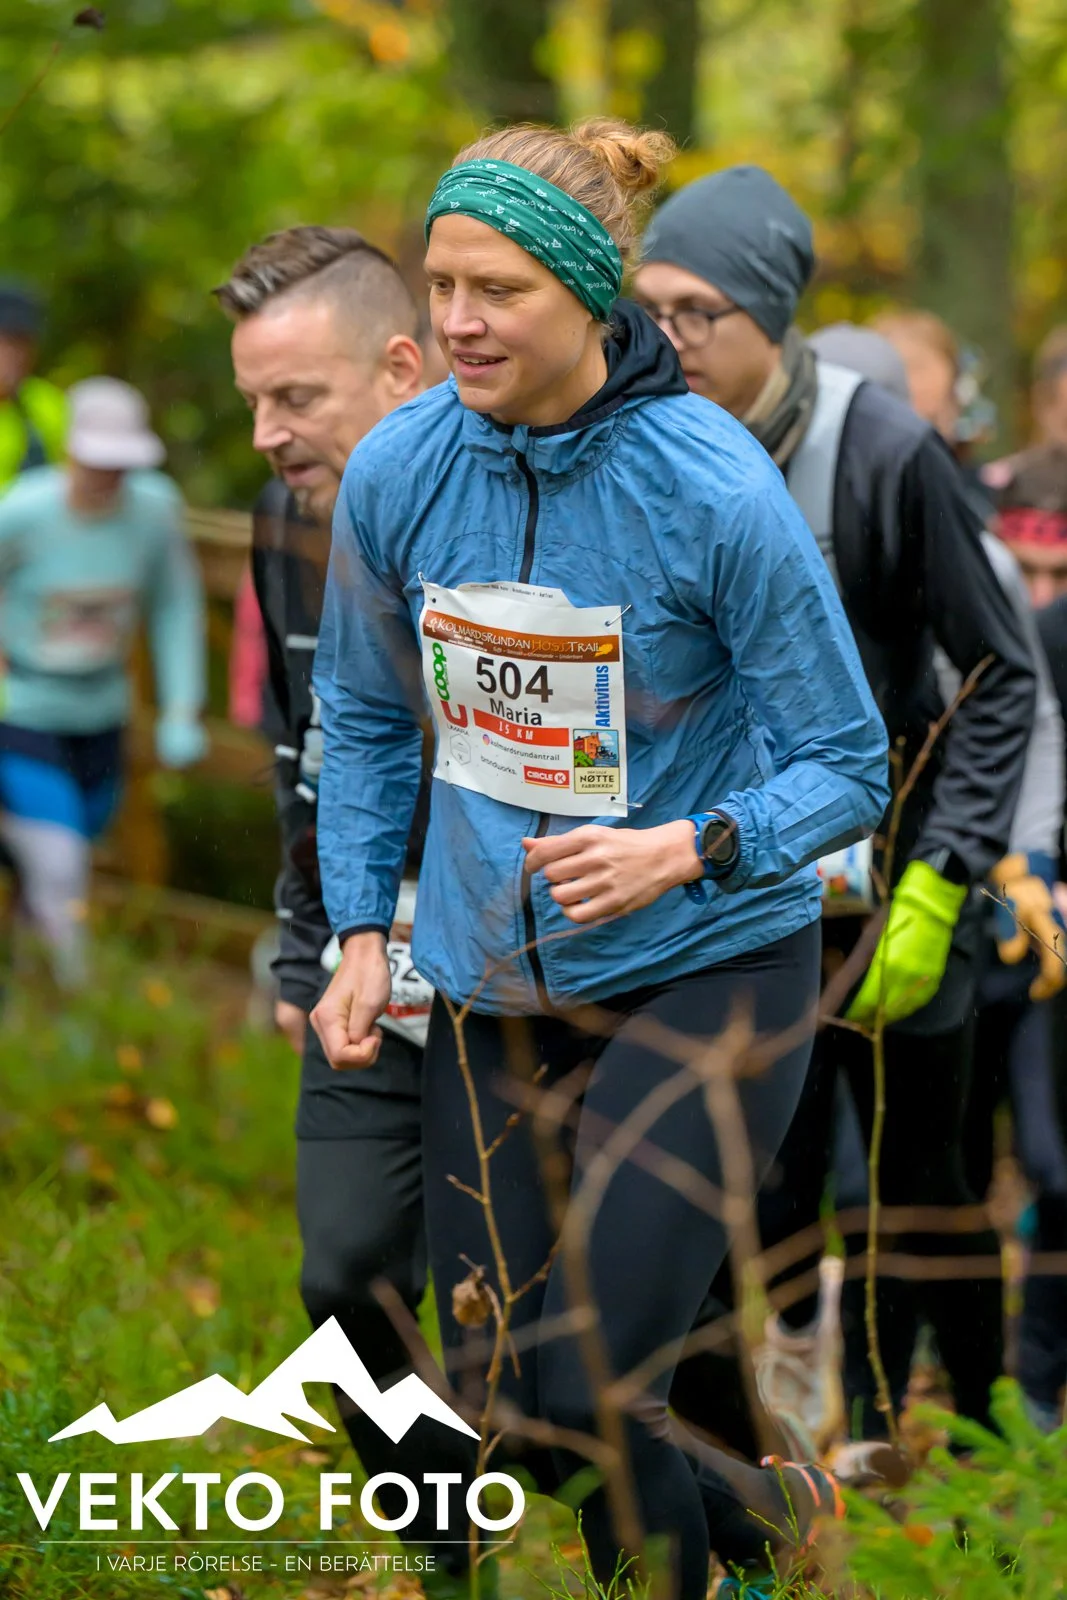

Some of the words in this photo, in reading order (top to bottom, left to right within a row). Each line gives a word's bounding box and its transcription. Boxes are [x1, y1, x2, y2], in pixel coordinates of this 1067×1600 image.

[432, 642, 450, 701] coop
[476, 656, 553, 703] 504
[594, 665, 611, 727] Aktivitus
[489, 698, 542, 726] Maria
[498, 721, 510, 735] 15
[517, 728, 534, 741] KM
[526, 769, 553, 782] CIRCLE
[579, 774, 615, 783] NØTTE
